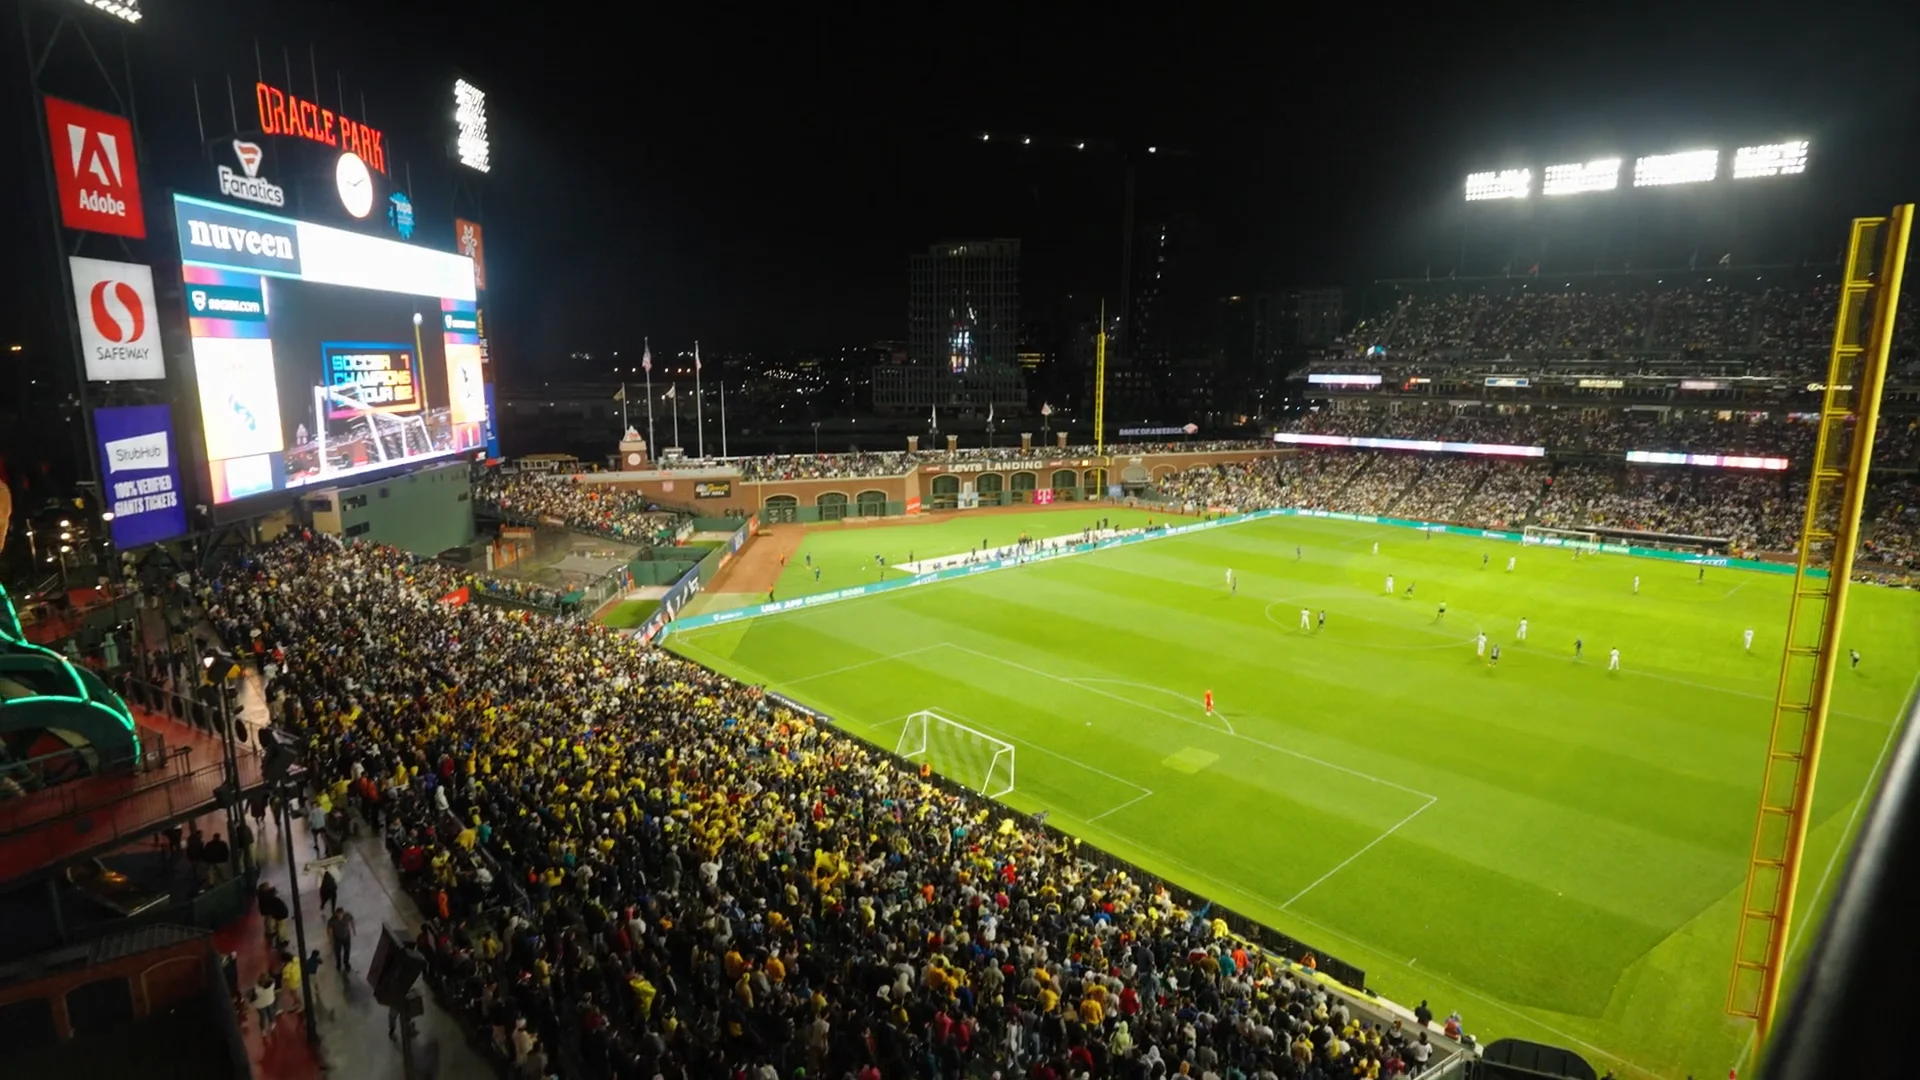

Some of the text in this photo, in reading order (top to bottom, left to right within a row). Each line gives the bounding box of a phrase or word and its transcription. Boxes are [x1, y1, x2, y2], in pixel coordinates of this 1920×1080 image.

[256, 82, 386, 175] ORACLE PARK
[219, 168, 284, 206] Fanatics
[79, 189, 126, 216] Adobe
[188, 220, 294, 260] nuveen
[96, 346, 150, 361] SAFEWAY
[116, 447, 161, 462] StubHub
[986, 460, 1043, 471] LANDING
[136, 475, 172, 495] VERIFIED
[114, 491, 177, 517] GIANTS TICKETS
